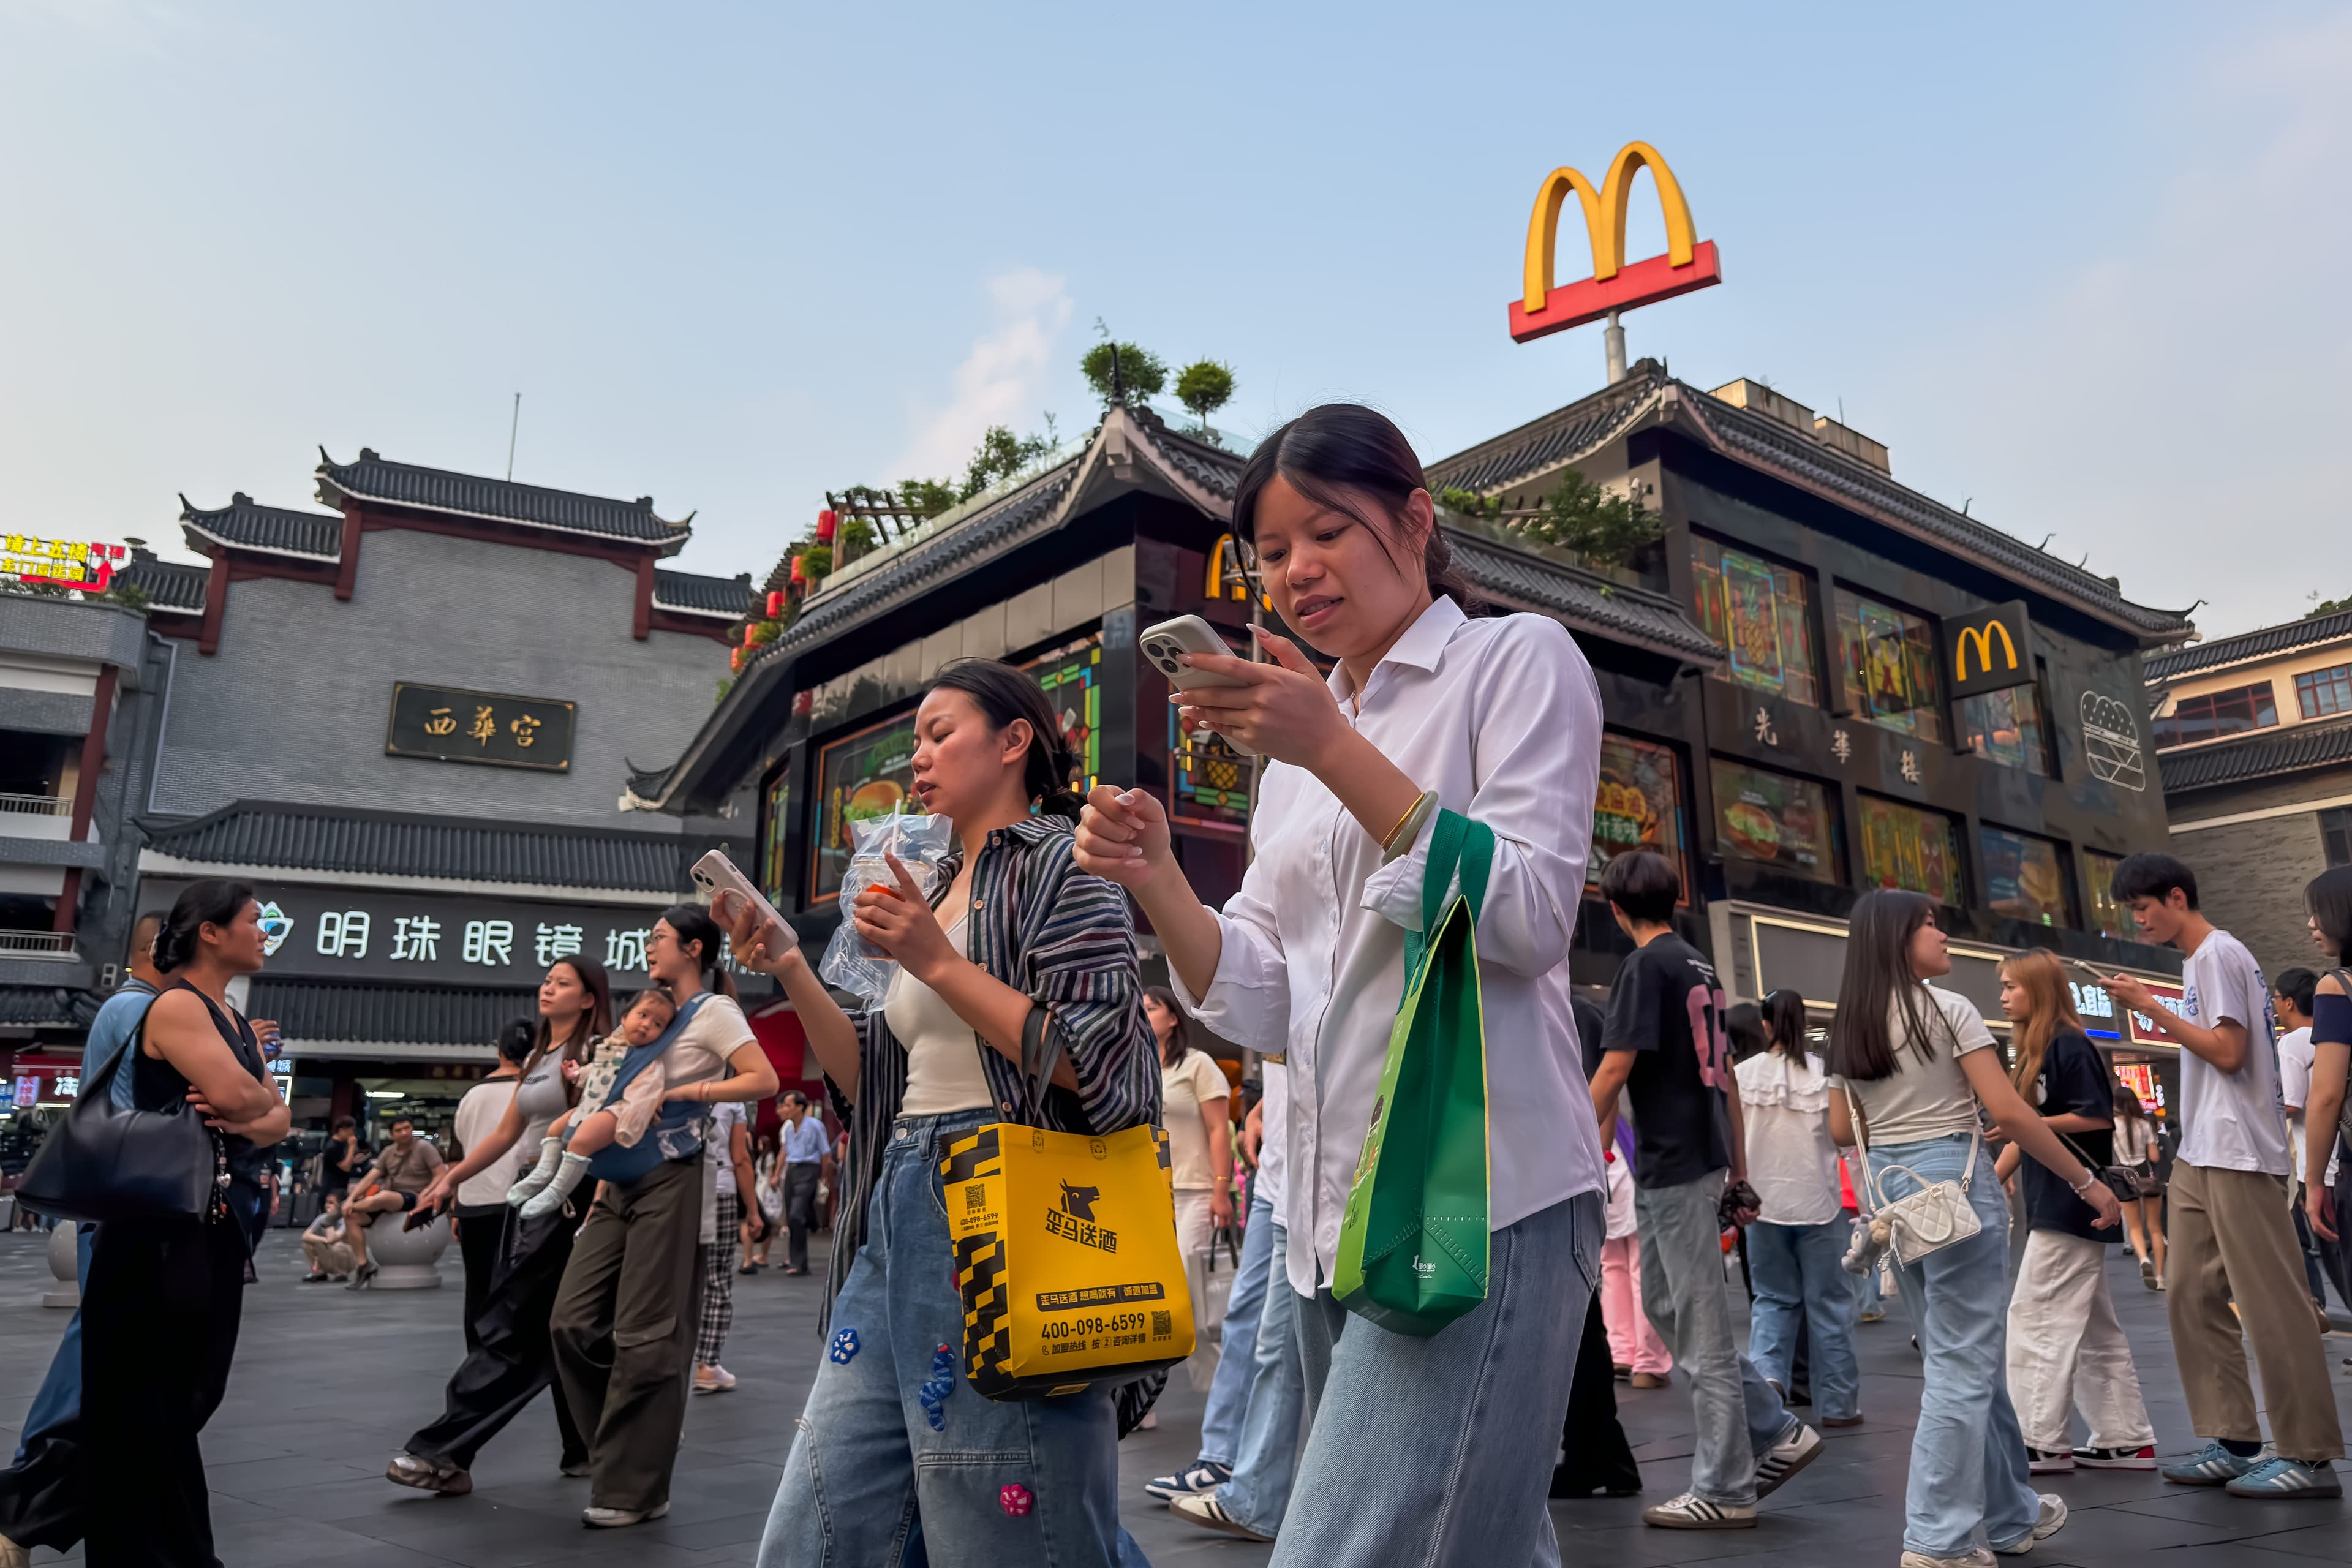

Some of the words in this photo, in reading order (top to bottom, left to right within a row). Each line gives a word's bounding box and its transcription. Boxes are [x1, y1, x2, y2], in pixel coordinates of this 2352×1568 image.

[316, 910, 652, 972] 明珠眼镜城
[1044, 1207, 1118, 1254] 歪马送酒
[1040, 1292, 1079, 1306] 歪马送酒
[1079, 1287, 1117, 1301] 想喝就有
[1123, 1284, 1159, 1297] 诚邀加盟
[1041, 1312, 1145, 1340] 400-098-6599
[1051, 1339, 1087, 1355] 加盟热线
